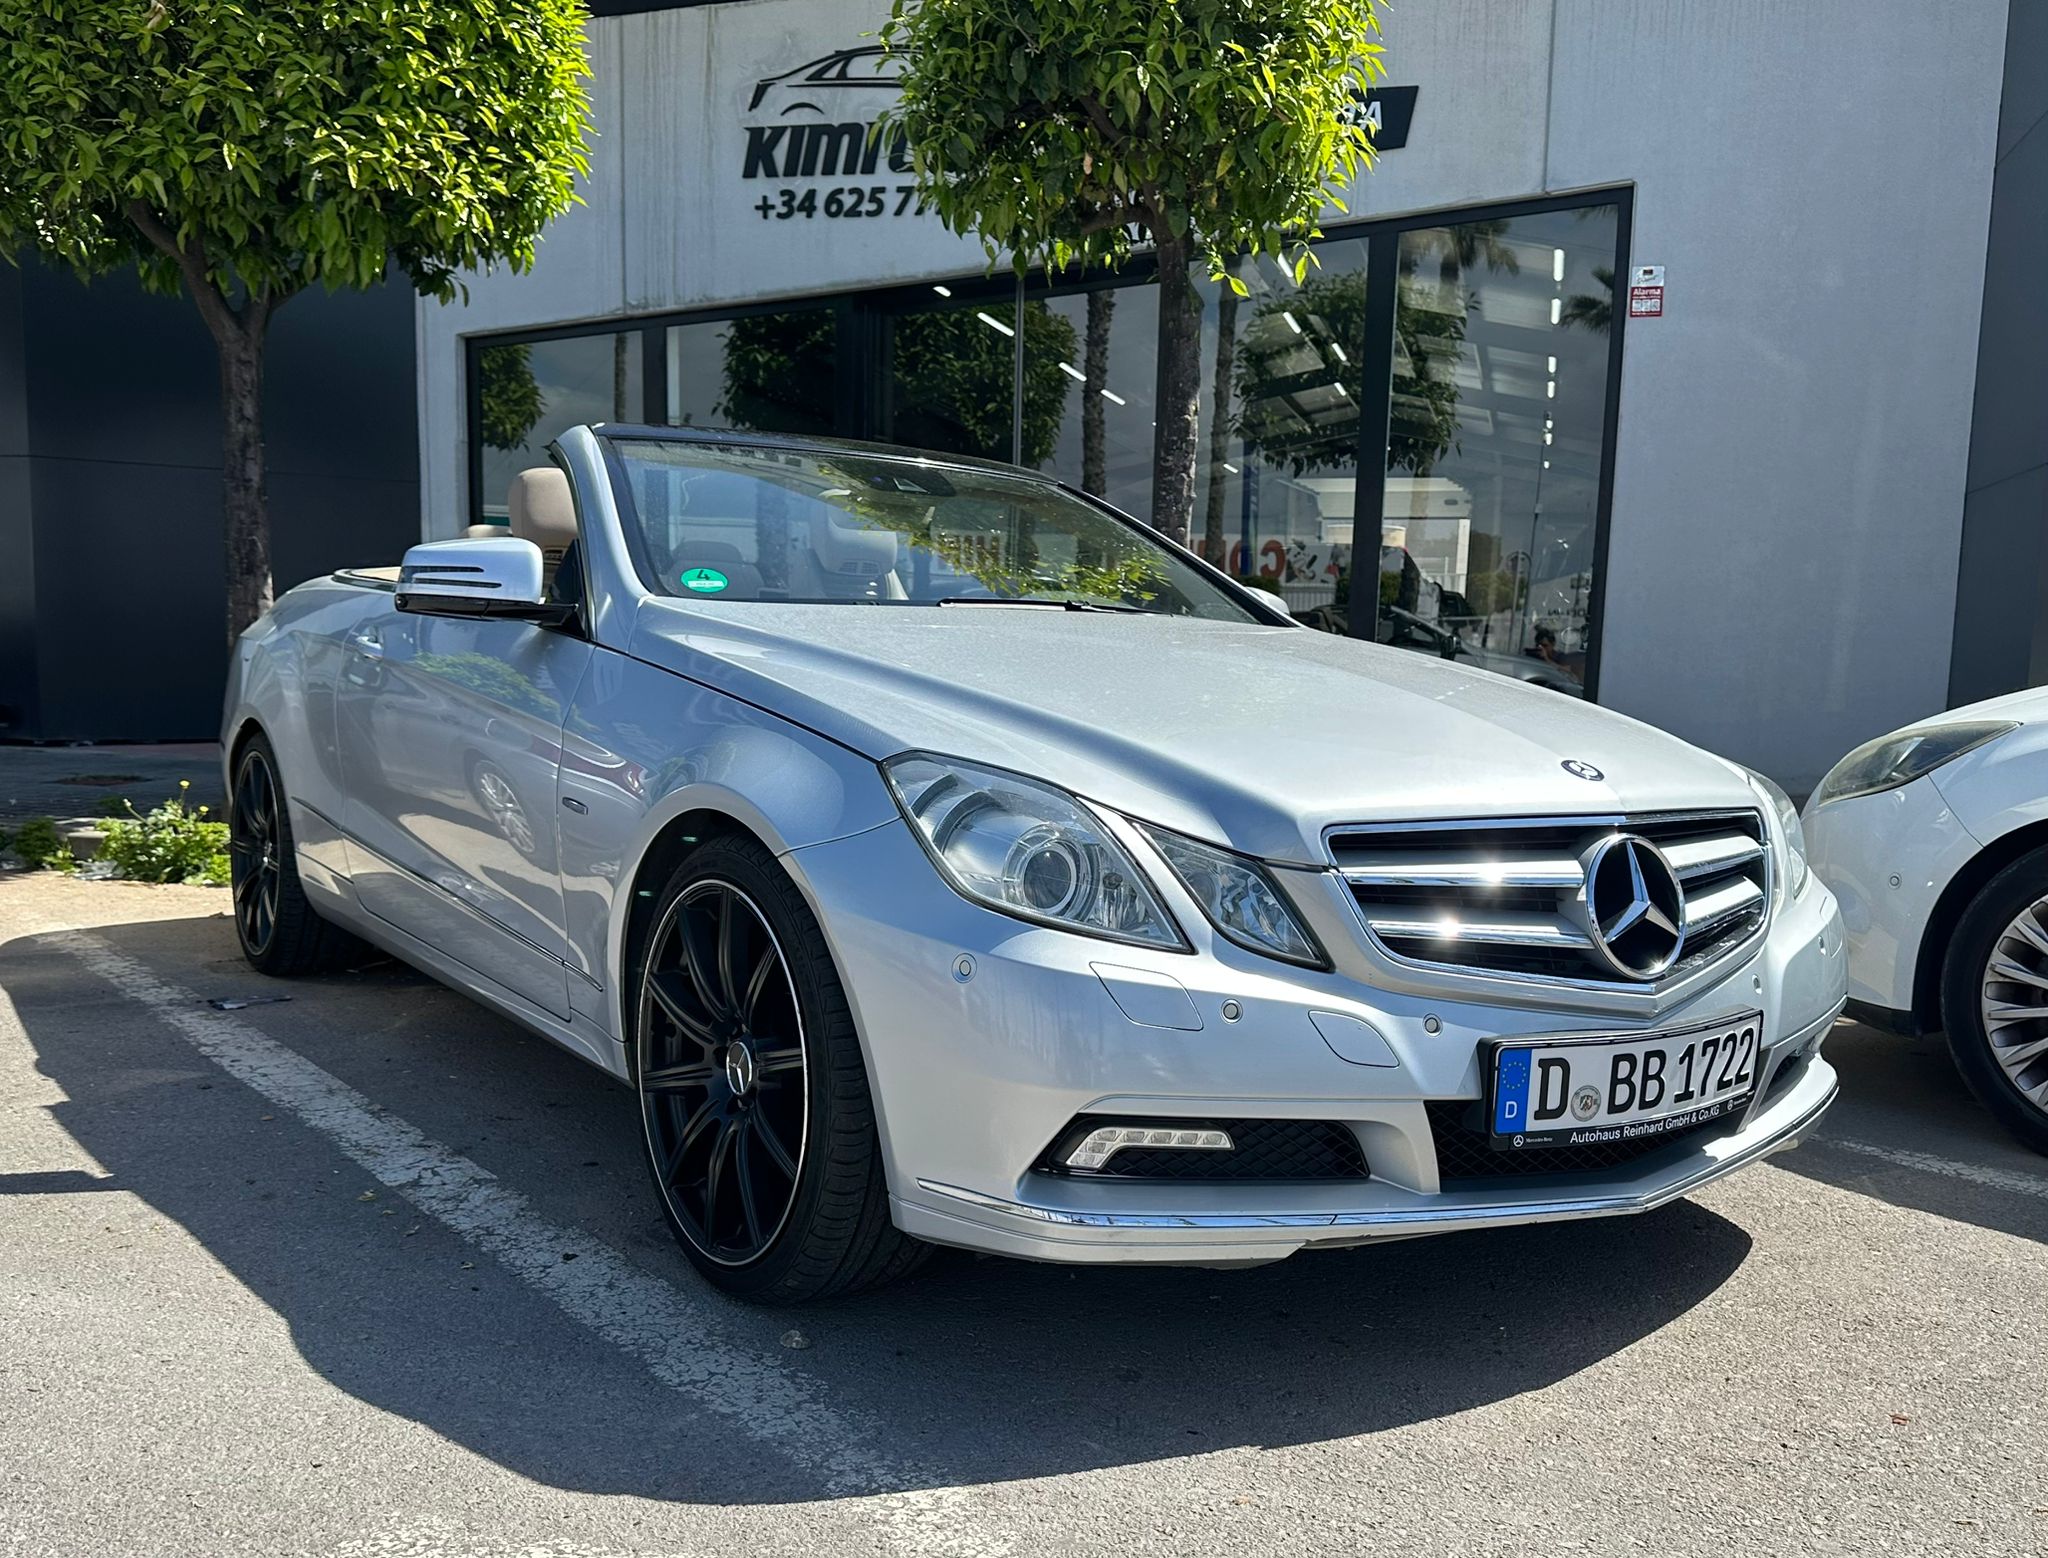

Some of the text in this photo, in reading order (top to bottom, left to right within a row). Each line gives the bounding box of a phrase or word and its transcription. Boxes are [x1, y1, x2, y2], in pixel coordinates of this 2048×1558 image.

[754, 188, 817, 220] +34
[824, 186, 886, 218] 625
[696, 569, 711, 581] 4
[1534, 1027, 1755, 1121] D BB 1722
[1504, 1100, 1518, 1119] D
[1570, 1104, 1720, 1144] Autohaus Reinhard GmbH & Co.KG
